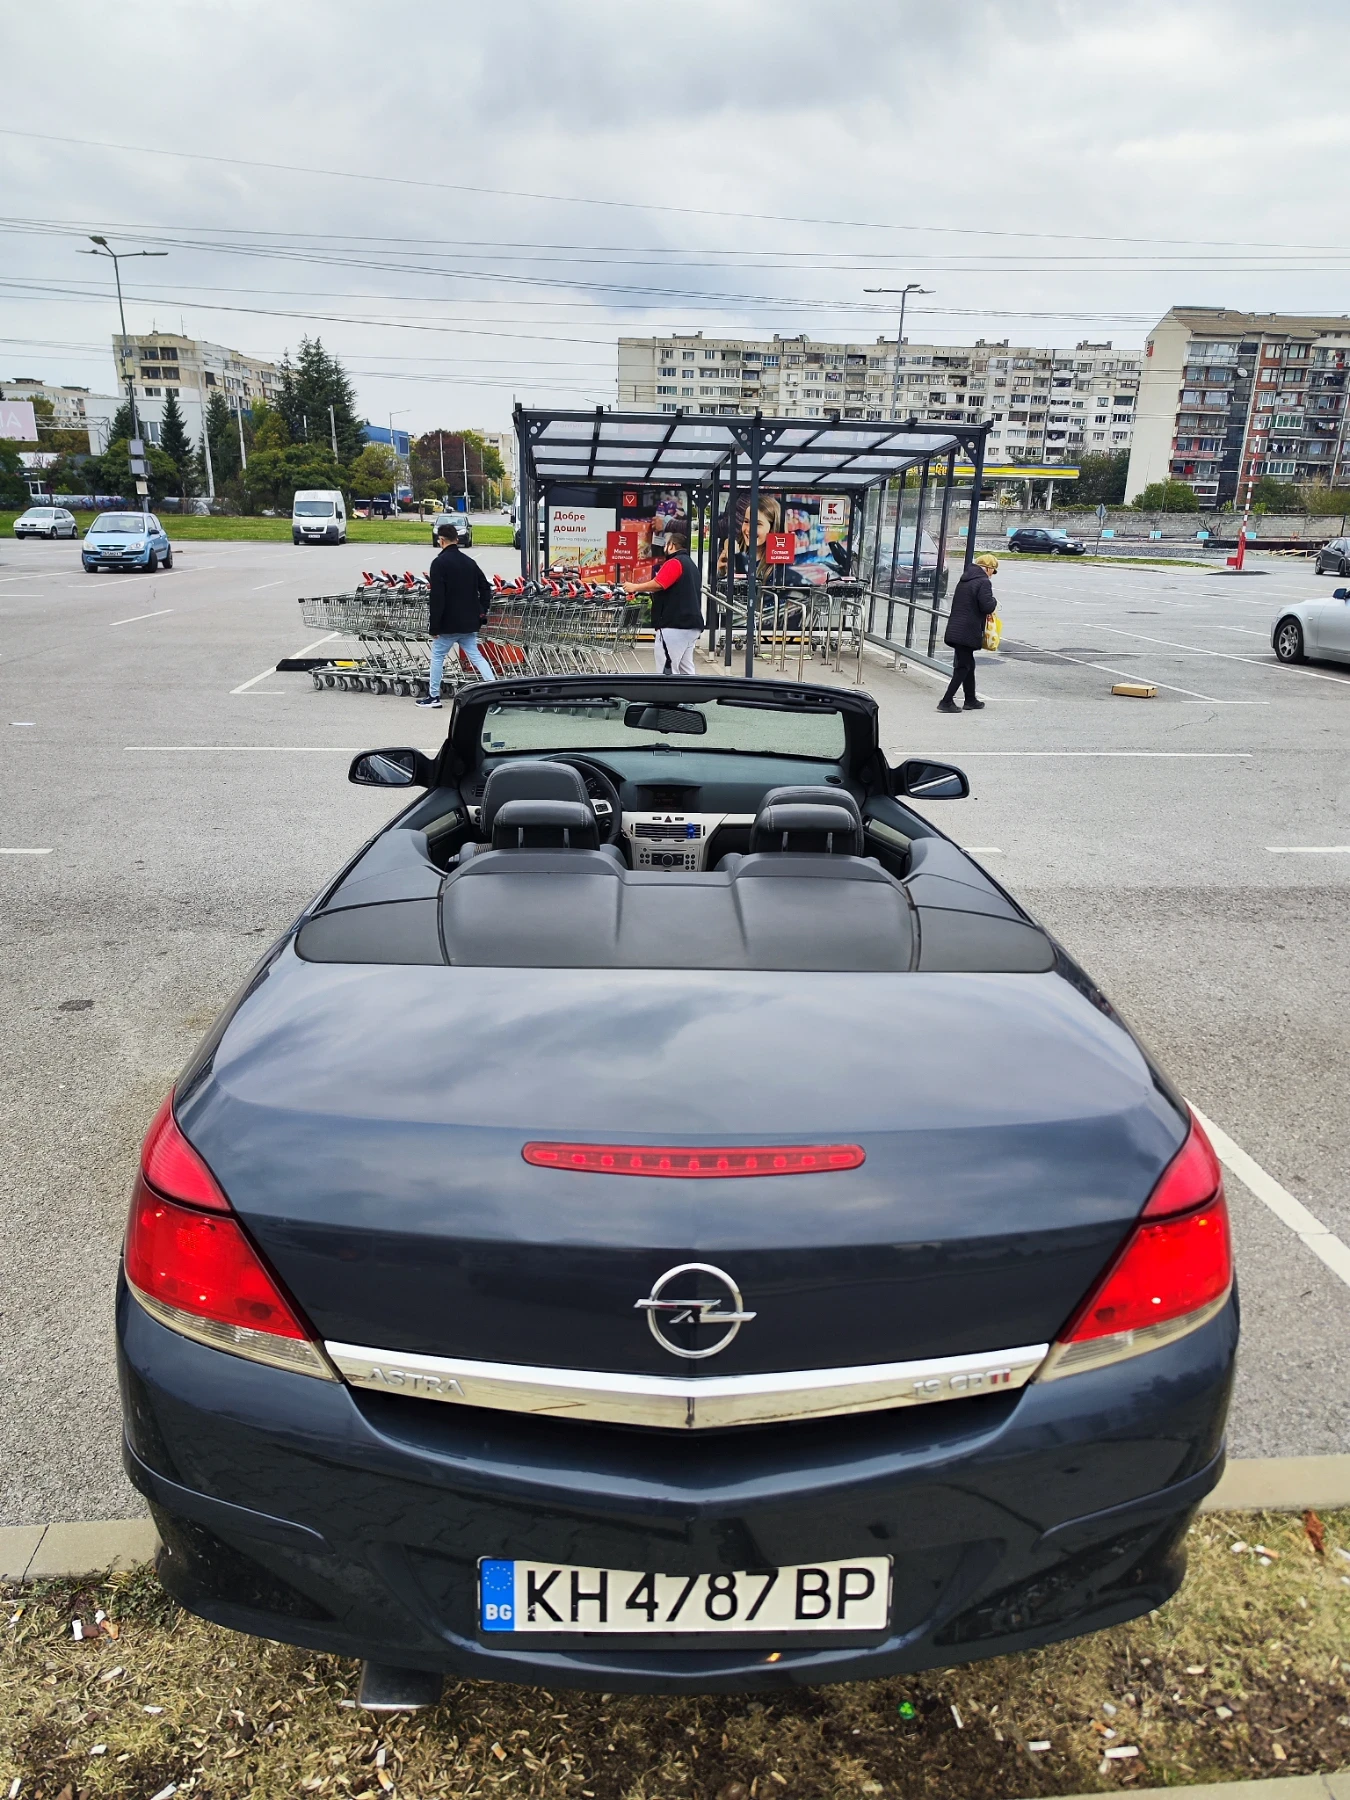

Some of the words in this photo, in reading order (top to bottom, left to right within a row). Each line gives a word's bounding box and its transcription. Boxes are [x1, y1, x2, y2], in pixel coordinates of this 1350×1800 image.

[554, 511, 585, 521] Добре
[366, 1366, 466, 1397] ASTRA
[526, 1569, 608, 1624] KH
[624, 1568, 781, 1623] 4787
[795, 1566, 876, 1621] BP
[485, 1603, 513, 1621] BG
